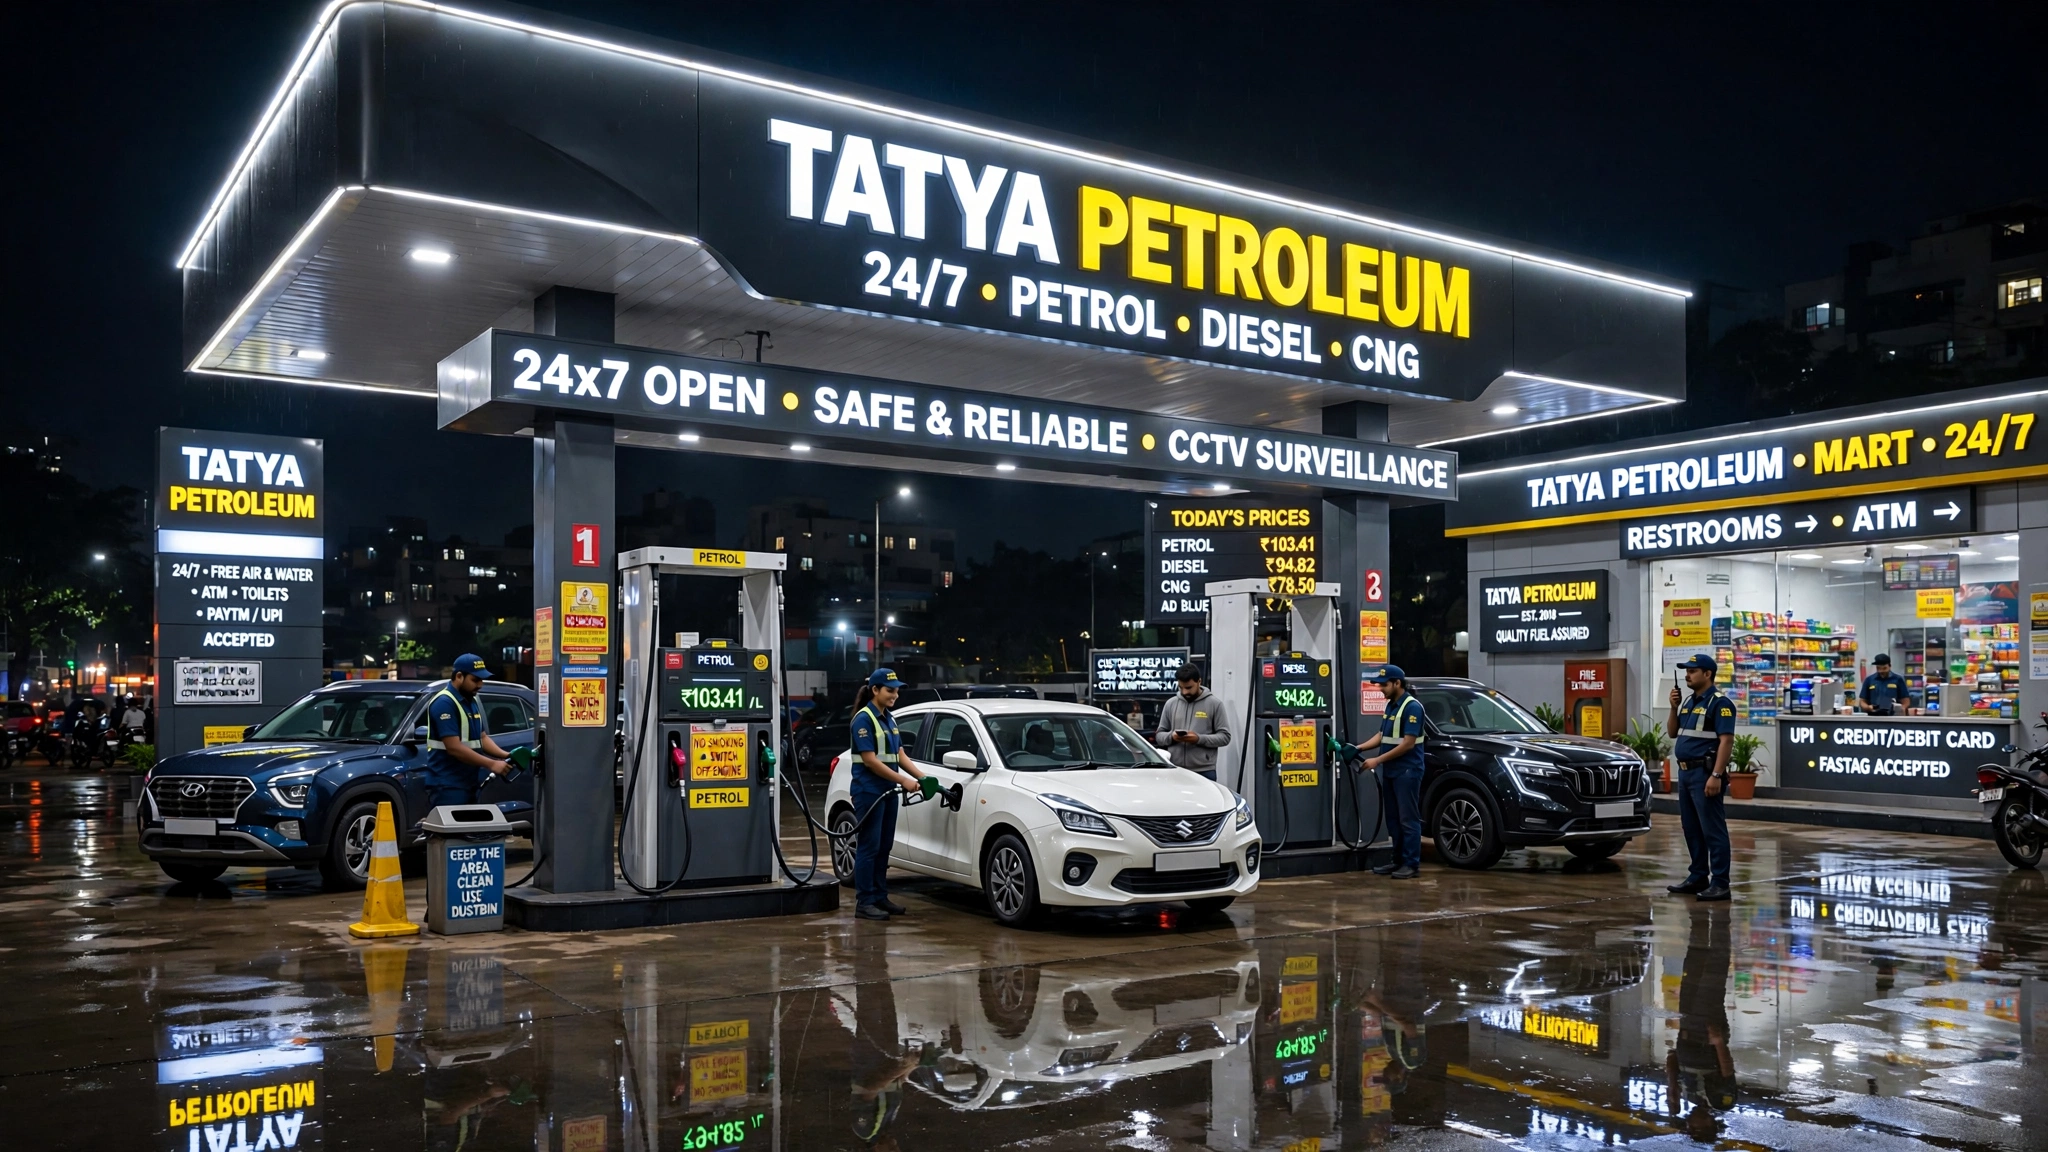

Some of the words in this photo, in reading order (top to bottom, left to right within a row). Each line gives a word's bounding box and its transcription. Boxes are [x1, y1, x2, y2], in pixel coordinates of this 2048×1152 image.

[766, 117, 1060, 265] TATYA
[1078, 185, 1471, 339] PETROLEUM
[864, 249, 968, 309] 24/7
[1009, 274, 1167, 341] PETROL
[1201, 308, 1322, 365] DIESEL
[1351, 335, 1420, 379] CNG
[513, 347, 629, 400] 24x7
[643, 365, 766, 416] OPEN
[813, 386, 916, 432] SAFE
[924, 400, 953, 438] &
[963, 404, 1128, 455] RELIABLE
[1168, 429, 1249, 468] CCTV
[1256, 444, 1448, 490] SURVEILLANCE
[181, 446, 305, 487] TATYA
[1527, 471, 1606, 508] TATYA
[1611, 446, 1784, 499] PETROLEUM
[1813, 429, 1915, 475] MART
[1944, 413, 2036, 460] 24/7
[169, 485, 315, 519] PETROLEUM
[1171, 509, 1245, 526] TODAY'S
[1249, 509, 1310, 526] PRICES
[1627, 513, 1782, 550] RESTROOMS
[1852, 500, 1917, 533] ATM
[576, 527, 593, 561] 1
[1161, 538, 1214, 552] PETROL
[1260, 536, 1315, 552] ₹103.41
[699, 552, 741, 565] PETROL
[1161, 560, 1209, 574] DIESEL
[1265, 557, 1316, 573] ₹94.82
[172, 562, 200, 580] 24/7
[210, 564, 240, 581] FREE
[242, 566, 262, 581] AIR
[264, 567, 273, 581] &
[274, 566, 313, 582] WATER
[202, 586, 228, 600] ATM
[241, 586, 289, 601] TOILETS
[1161, 580, 1190, 594] CNG
[1267, 577, 1316, 594] ₹78.50
[1485, 587, 1522, 606] TATYA
[1523, 581, 1596, 604] PETROLEUM
[1161, 600, 1178, 612] AD
[1181, 599, 1210, 612] BLUE
[206, 608, 250, 622] PAYTM
[252, 607, 259, 623] /
[261, 608, 283, 623] UPI
[203, 632, 275, 648] ACCEPTED
[1495, 629, 1529, 644] QUALITY
[1530, 628, 1550, 641] FUEL
[1551, 626, 1590, 641] ASSURED
[697, 655, 734, 666] PETROL
[681, 687, 743, 708] ₹103.41
[749, 696, 764, 709] /L
[1790, 727, 1815, 744] UPI
[1833, 727, 1941, 748] CREDIT/DEBIT
[1946, 730, 1995, 749] CARD
[1819, 756, 1871, 775] FASTAG
[1873, 758, 1951, 778] ACCEPTED
[1283, 774, 1314, 783] PETROL
[696, 792, 743, 804] PETROL
[479, 847, 501, 859] THE
[459, 861, 490, 875] AREA
[456, 874, 494, 889] CLEAN
[461, 889, 483, 903] USE
[451, 902, 498, 918] DUSTBIN
